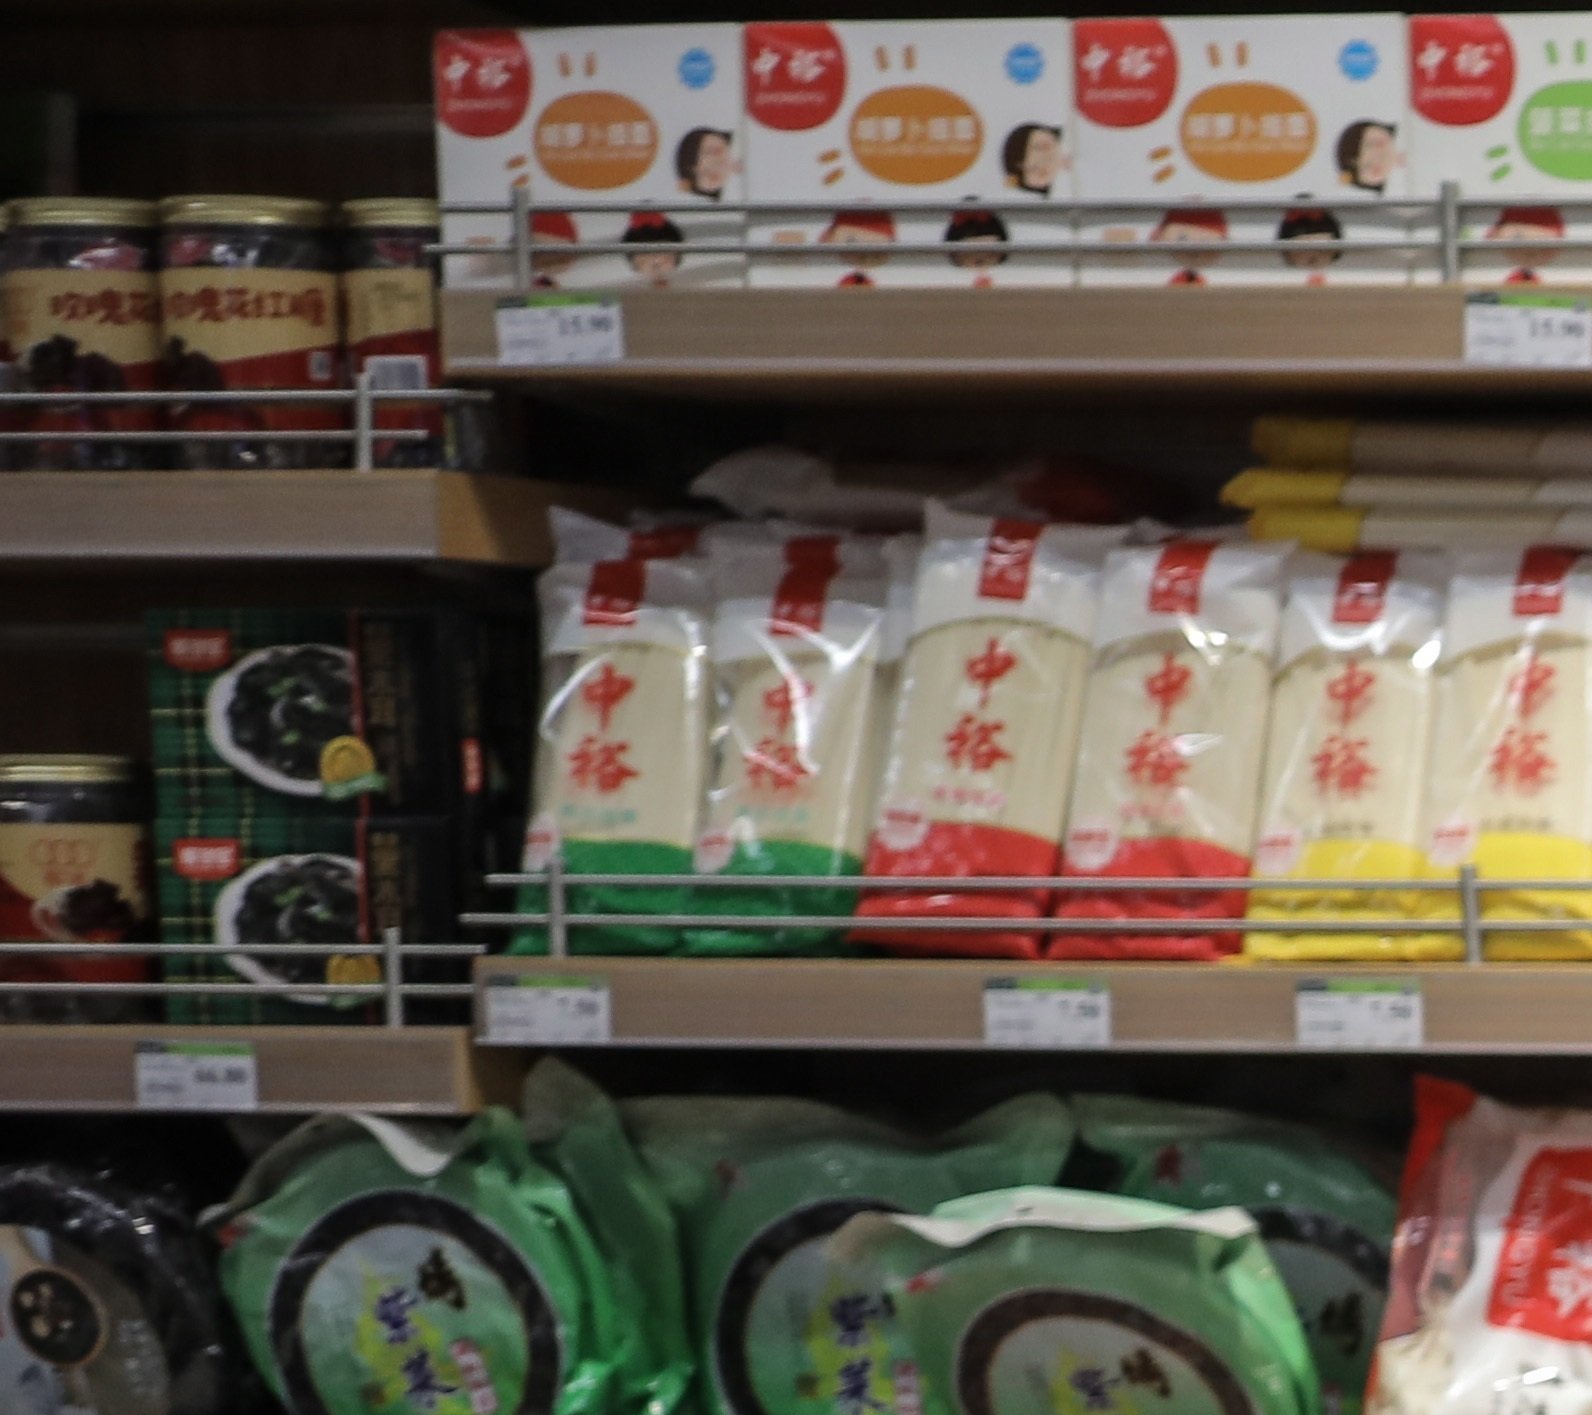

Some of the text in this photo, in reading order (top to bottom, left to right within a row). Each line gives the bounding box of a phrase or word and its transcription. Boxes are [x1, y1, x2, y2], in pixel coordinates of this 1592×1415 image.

[567, 663, 644, 793] 中裕
[944, 638, 1017, 773] 中裕
[1126, 652, 1193, 787] 中裕
